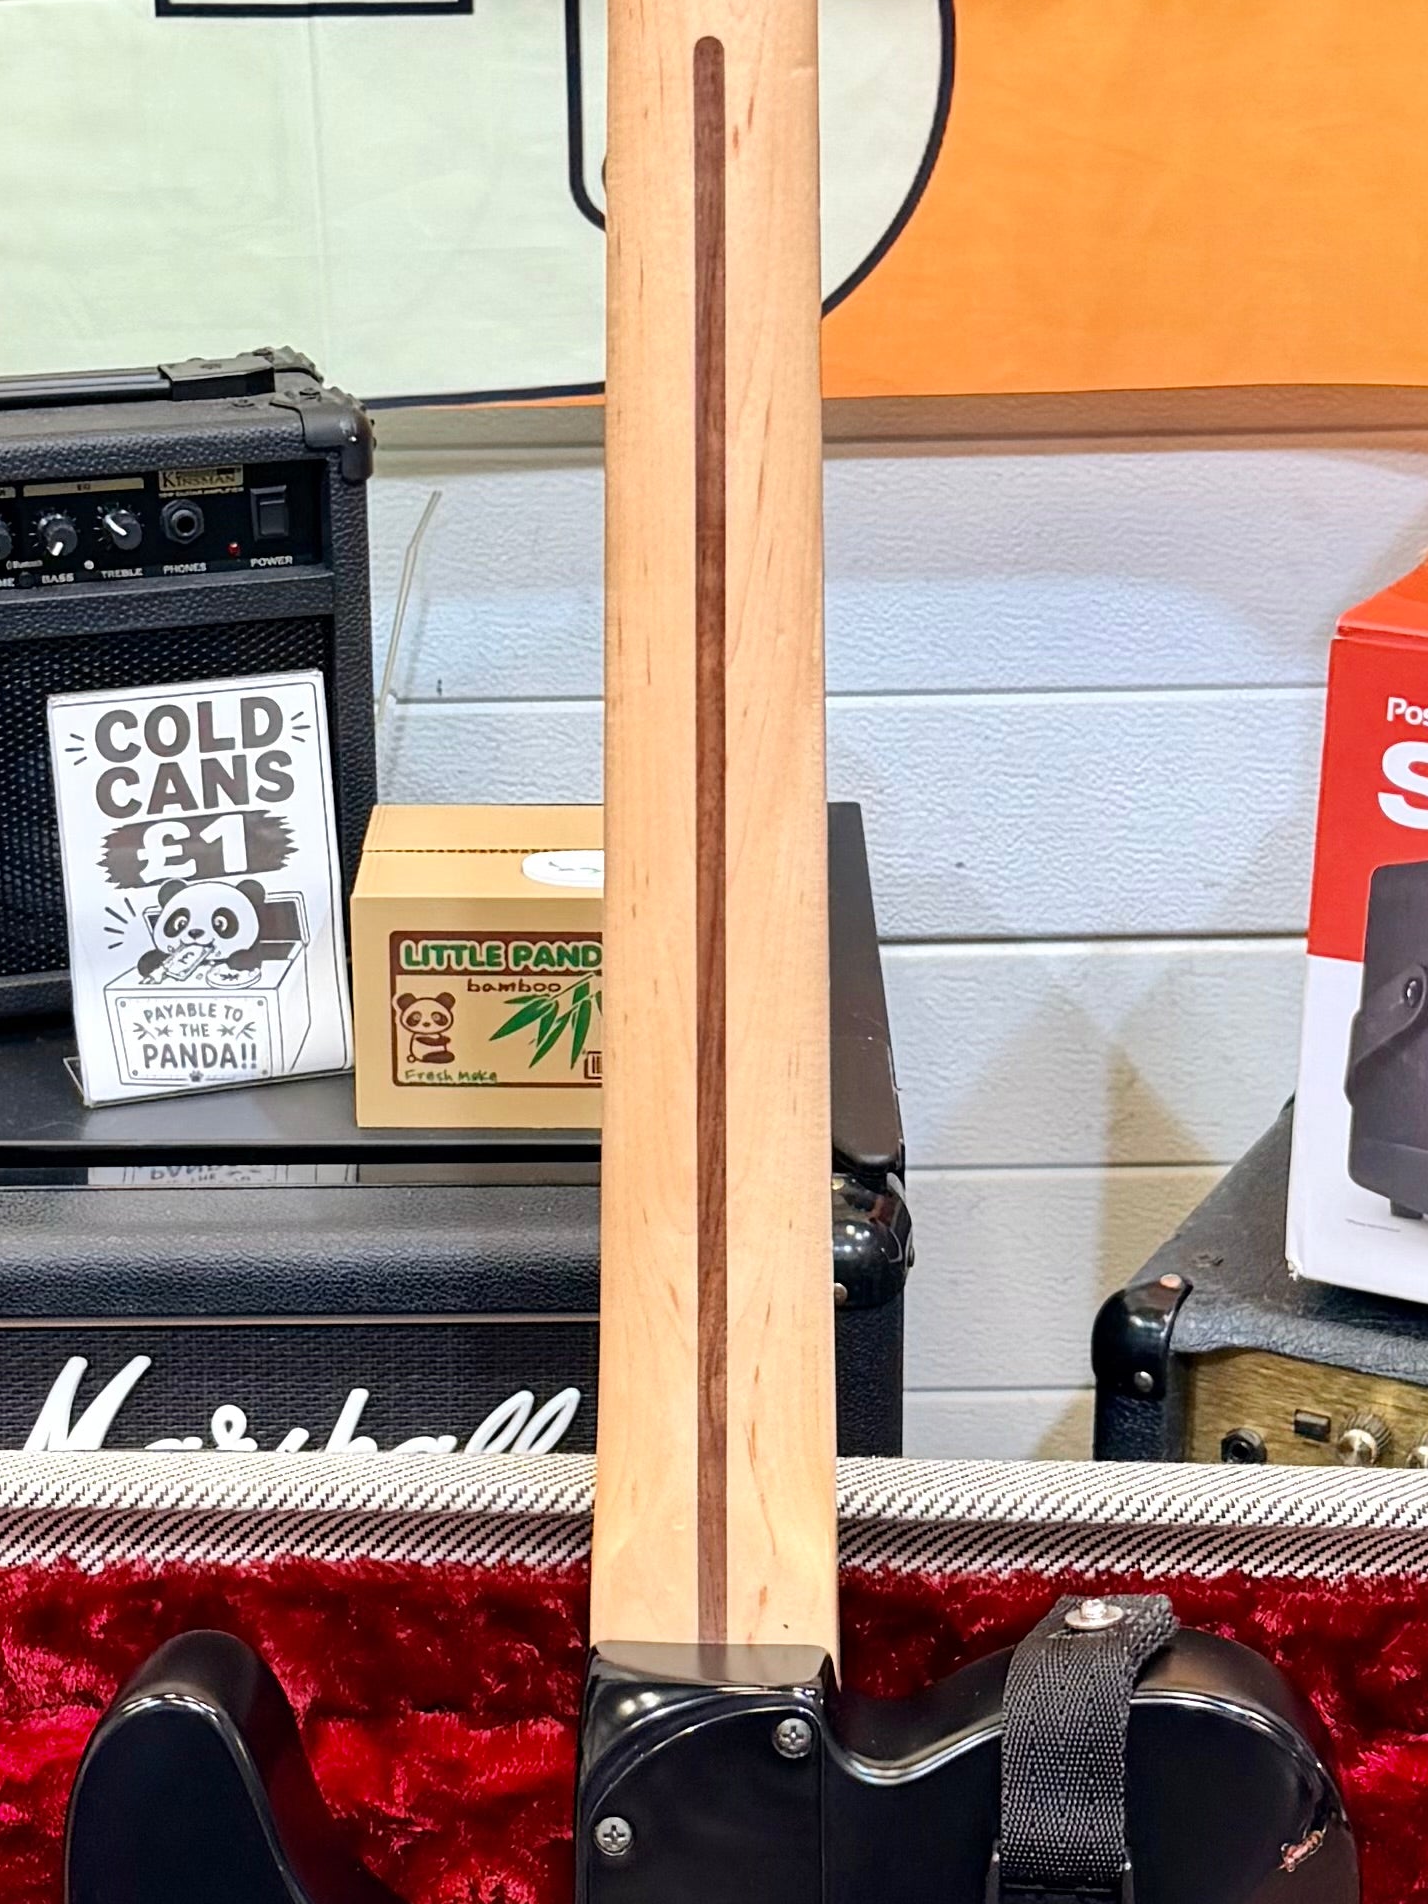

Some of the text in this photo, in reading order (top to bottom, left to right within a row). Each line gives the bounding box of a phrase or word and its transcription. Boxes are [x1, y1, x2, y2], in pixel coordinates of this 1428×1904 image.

[163, 562, 207, 575] PHONES
[250, 555, 293, 567] POWER
[41, 573, 75, 584] BASS
[101, 567, 143, 579] TREBLE
[95, 696, 283, 763] COLD
[95, 749, 295, 819] CANS
[136, 813, 248, 884] £1
[402, 942, 504, 969] LITTLE
[466, 978, 562, 994] bamboo
[143, 1002, 244, 1024] PAYABLE TO
[179, 1023, 210, 1038] THE
[142, 1042, 257, 1069] PANDA!!
[404, 1069, 454, 1082] Fresh
